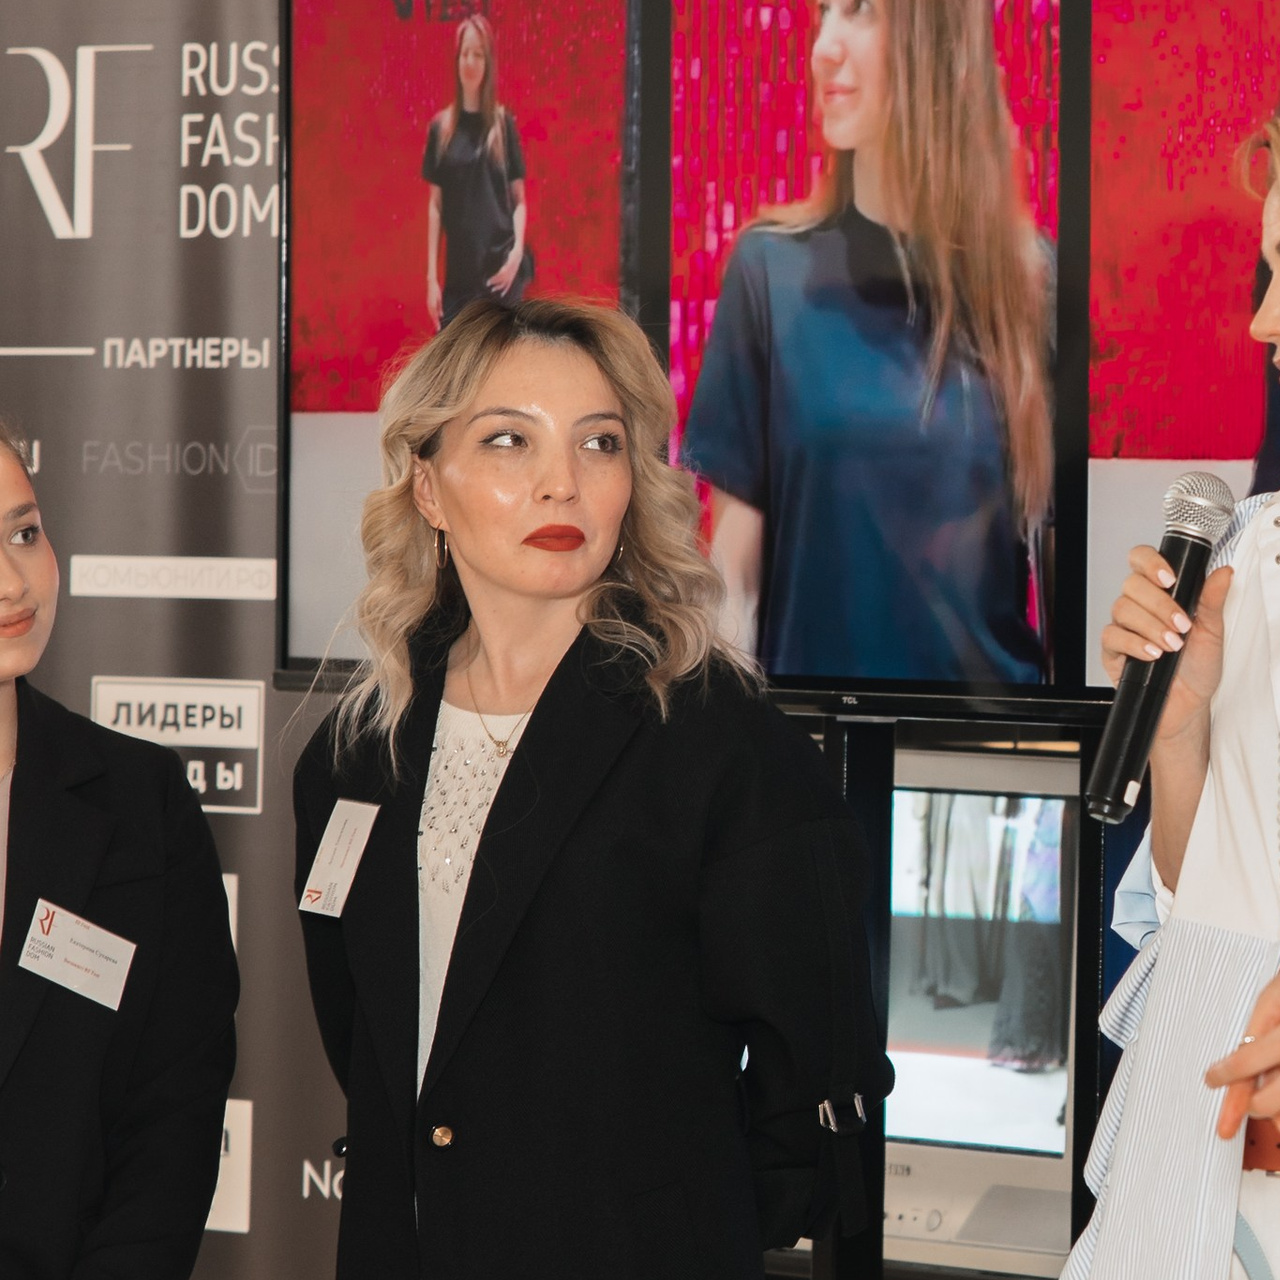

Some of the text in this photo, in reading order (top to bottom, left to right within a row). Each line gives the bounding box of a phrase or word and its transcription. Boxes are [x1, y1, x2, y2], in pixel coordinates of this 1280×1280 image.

[179, 183, 280, 239] DOM
[103, 337, 270, 369] ПАРТНЕРЫ
[82, 440, 229, 476] FASHION
[842, 696, 858, 705] TCL
[112, 702, 243, 731] ЛИДЕРЫ
[28, 943, 54, 960] FASHION
[30, 936, 56, 952] RUSSIAN
[26, 950, 40, 962] DOM
